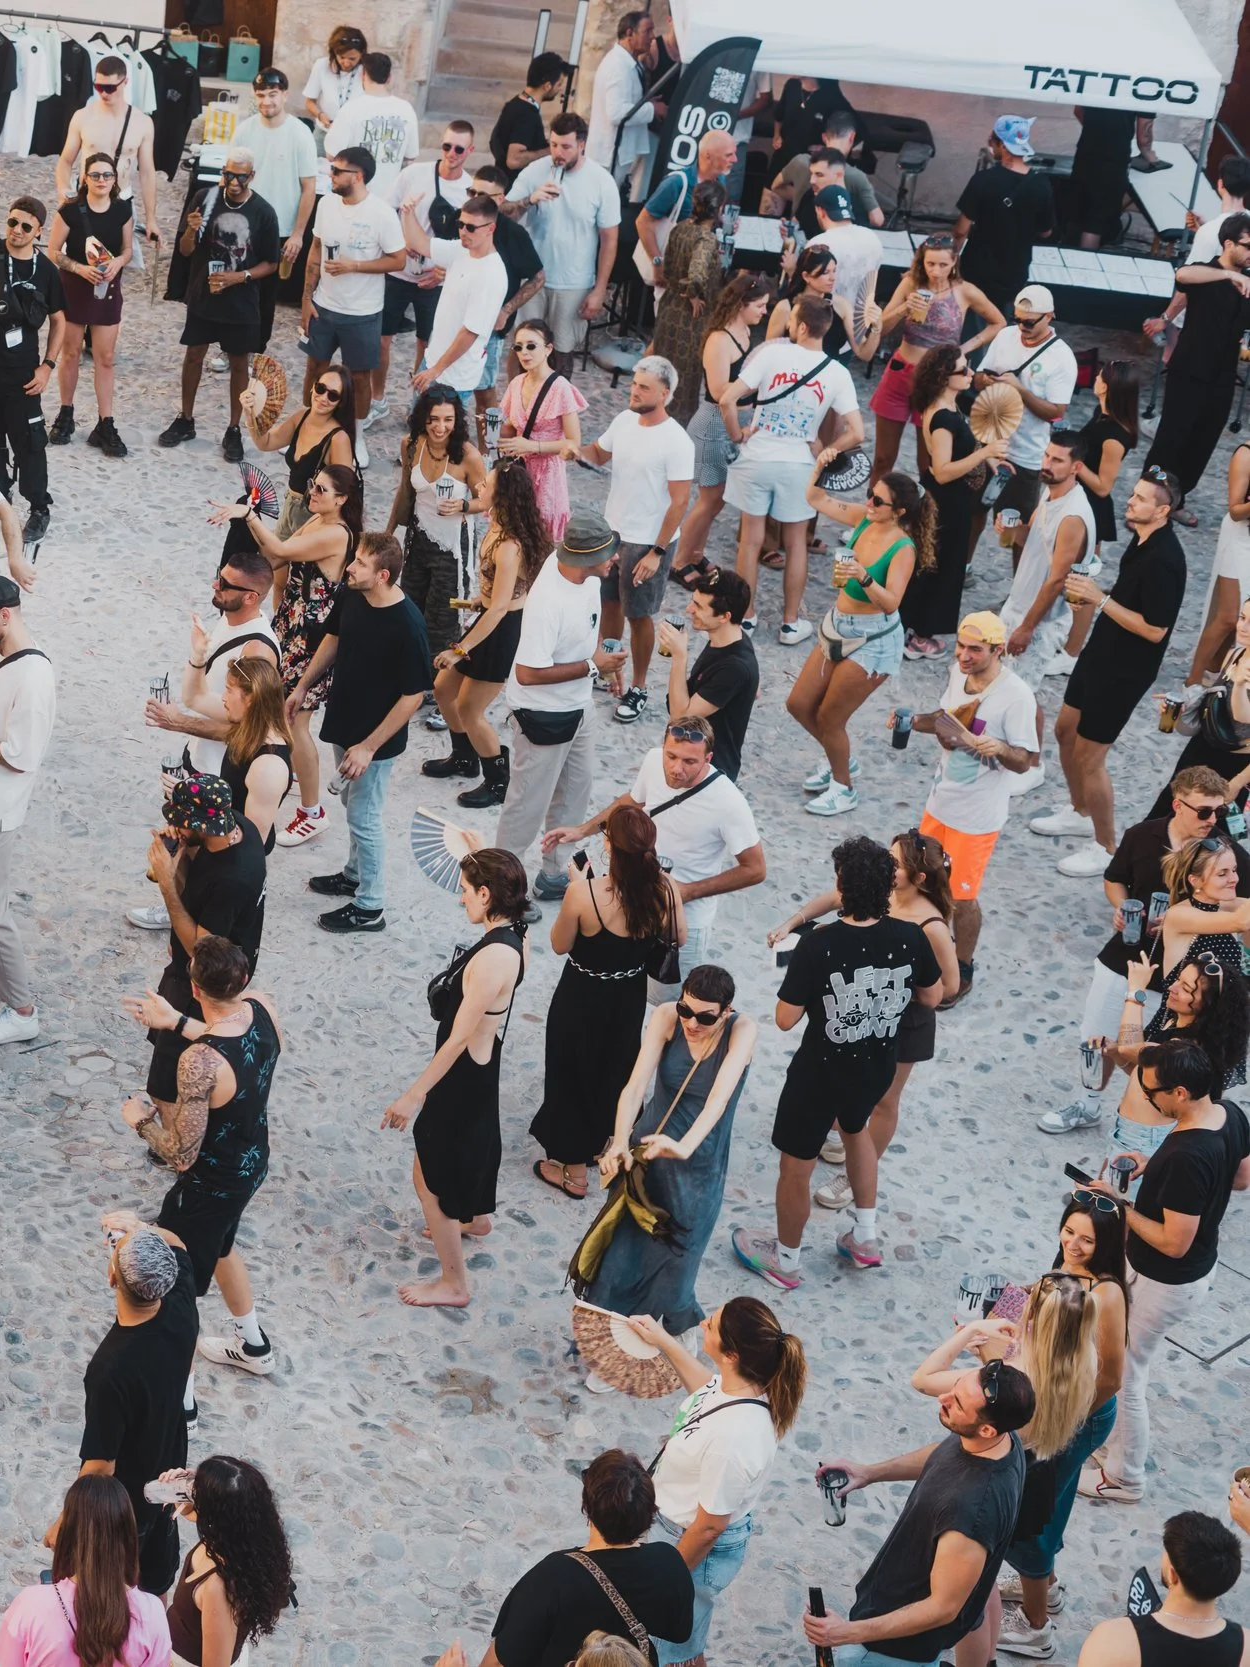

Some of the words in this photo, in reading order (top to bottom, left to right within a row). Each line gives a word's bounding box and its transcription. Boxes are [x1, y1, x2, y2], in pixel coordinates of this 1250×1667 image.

[1024, 65, 1199, 105] TATTOO
[830, 964, 912, 998] LEFT
[825, 1014, 902, 1044] GIANT
